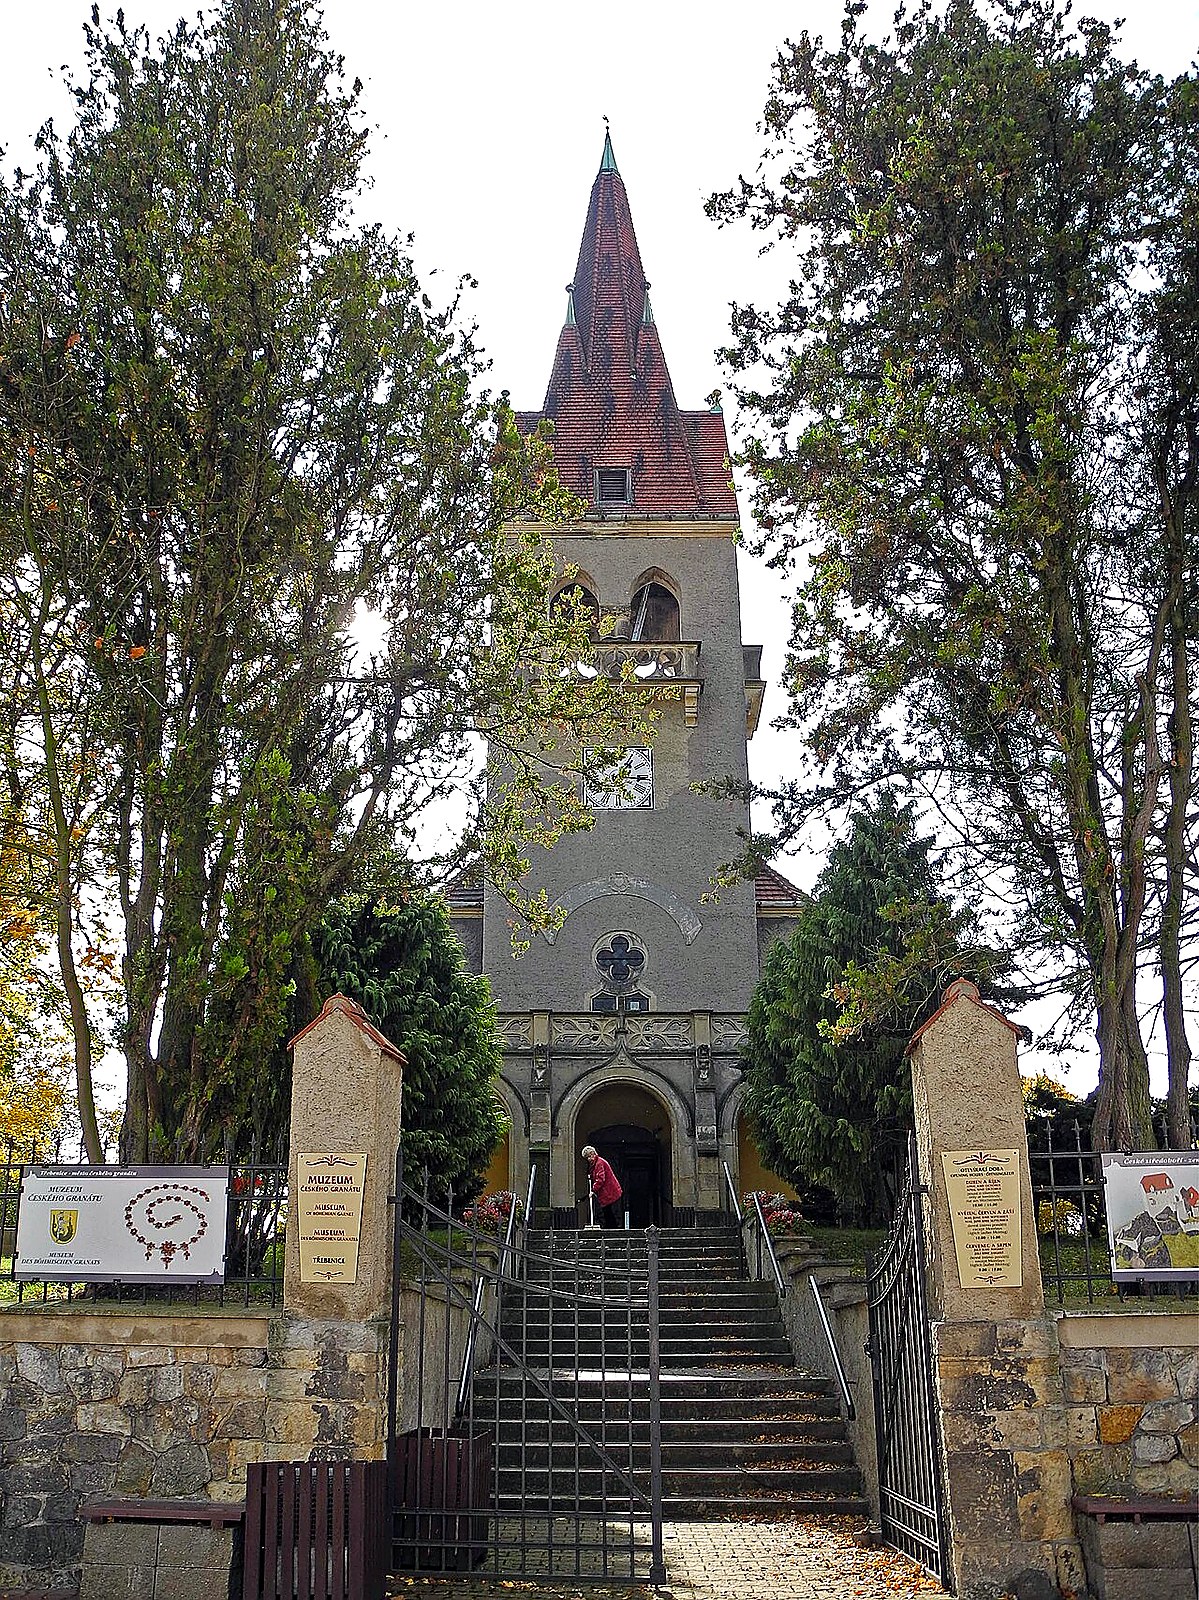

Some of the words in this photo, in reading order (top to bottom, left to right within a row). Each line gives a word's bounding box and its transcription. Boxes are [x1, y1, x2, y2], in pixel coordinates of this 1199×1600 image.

[308, 1176, 353, 1184] MUZEUM
[66, 1194, 103, 1202] GRANÁTU
[313, 1256, 345, 1264] TŘEBENICE
